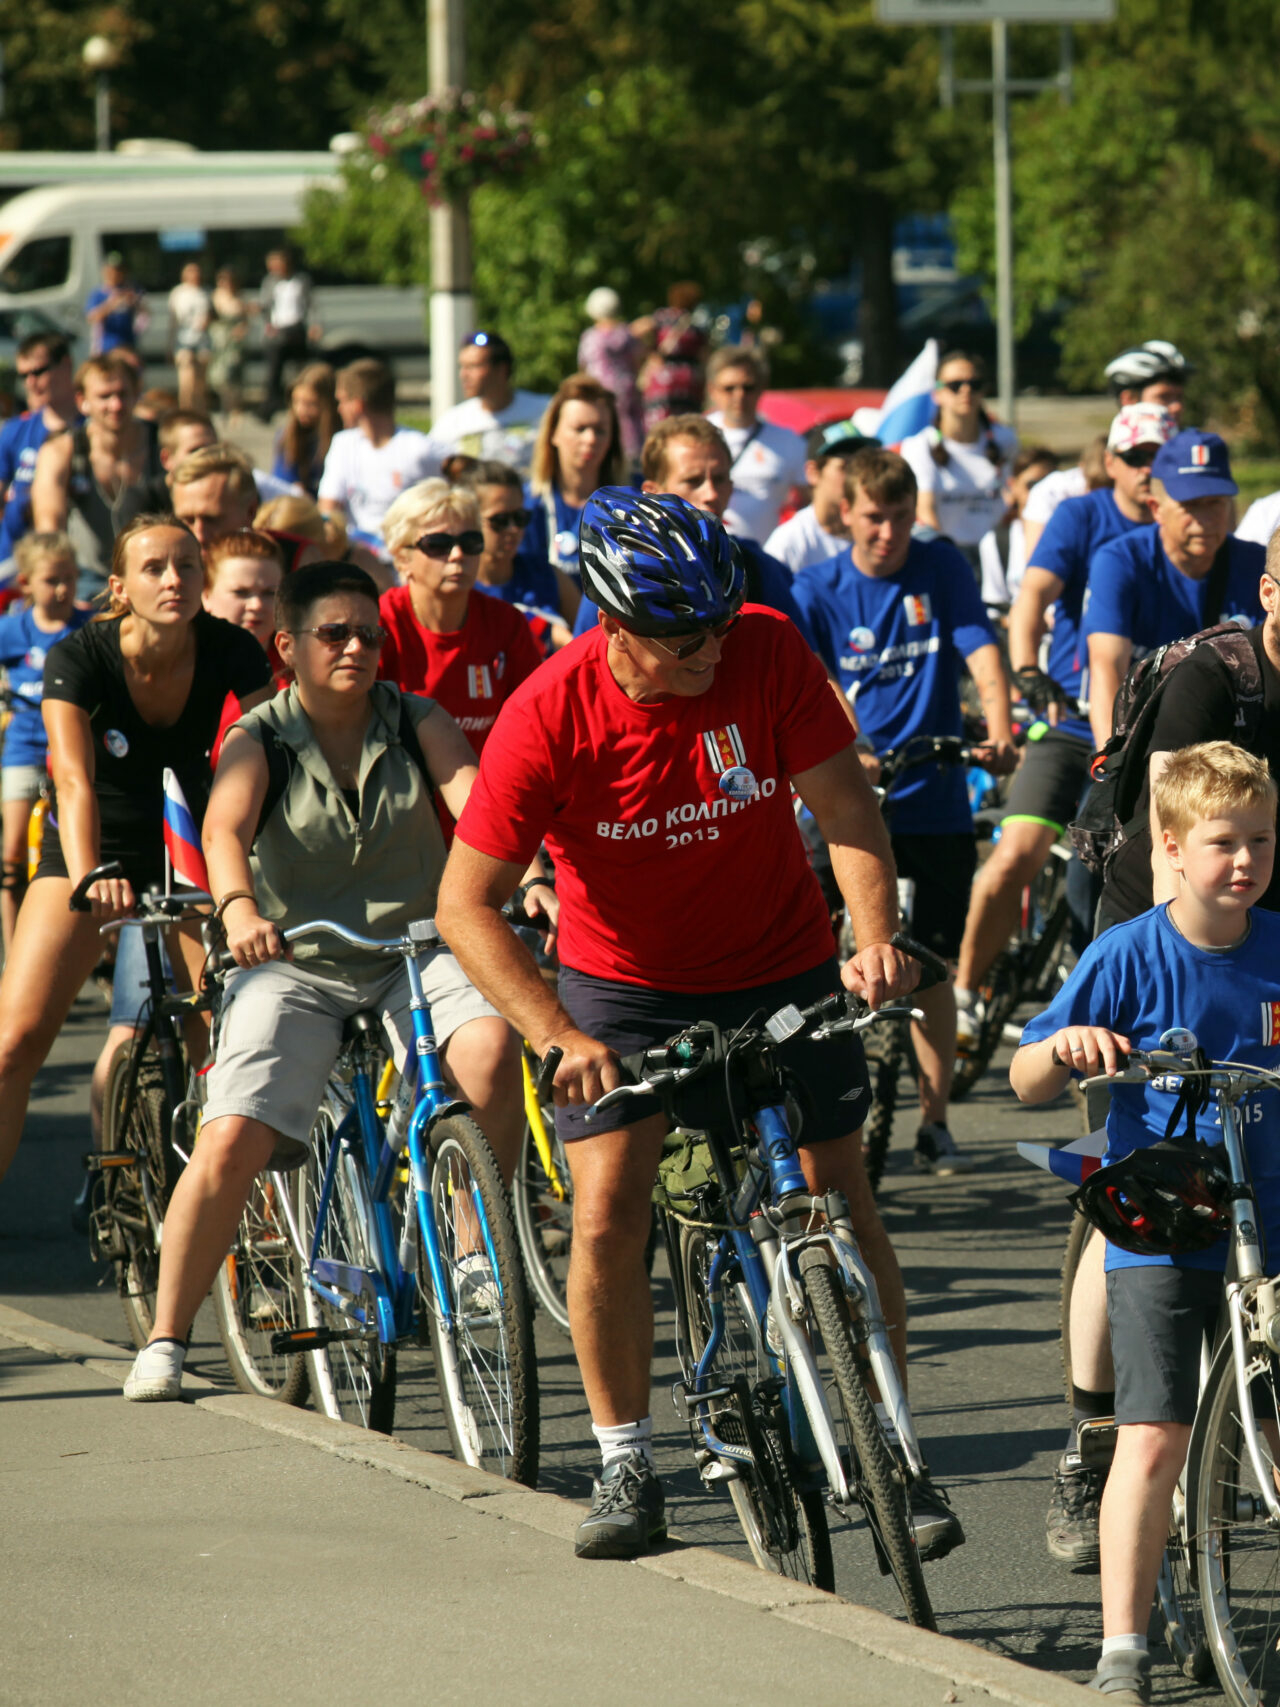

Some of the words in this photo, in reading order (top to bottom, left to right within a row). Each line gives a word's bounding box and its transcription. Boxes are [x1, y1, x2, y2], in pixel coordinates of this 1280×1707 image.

[596, 818, 659, 840] ВЕЛО
[665, 826, 720, 849] 2015
[1152, 1076, 1185, 1093] ВЕ
[721, 1445, 752, 1457] AUTHO
